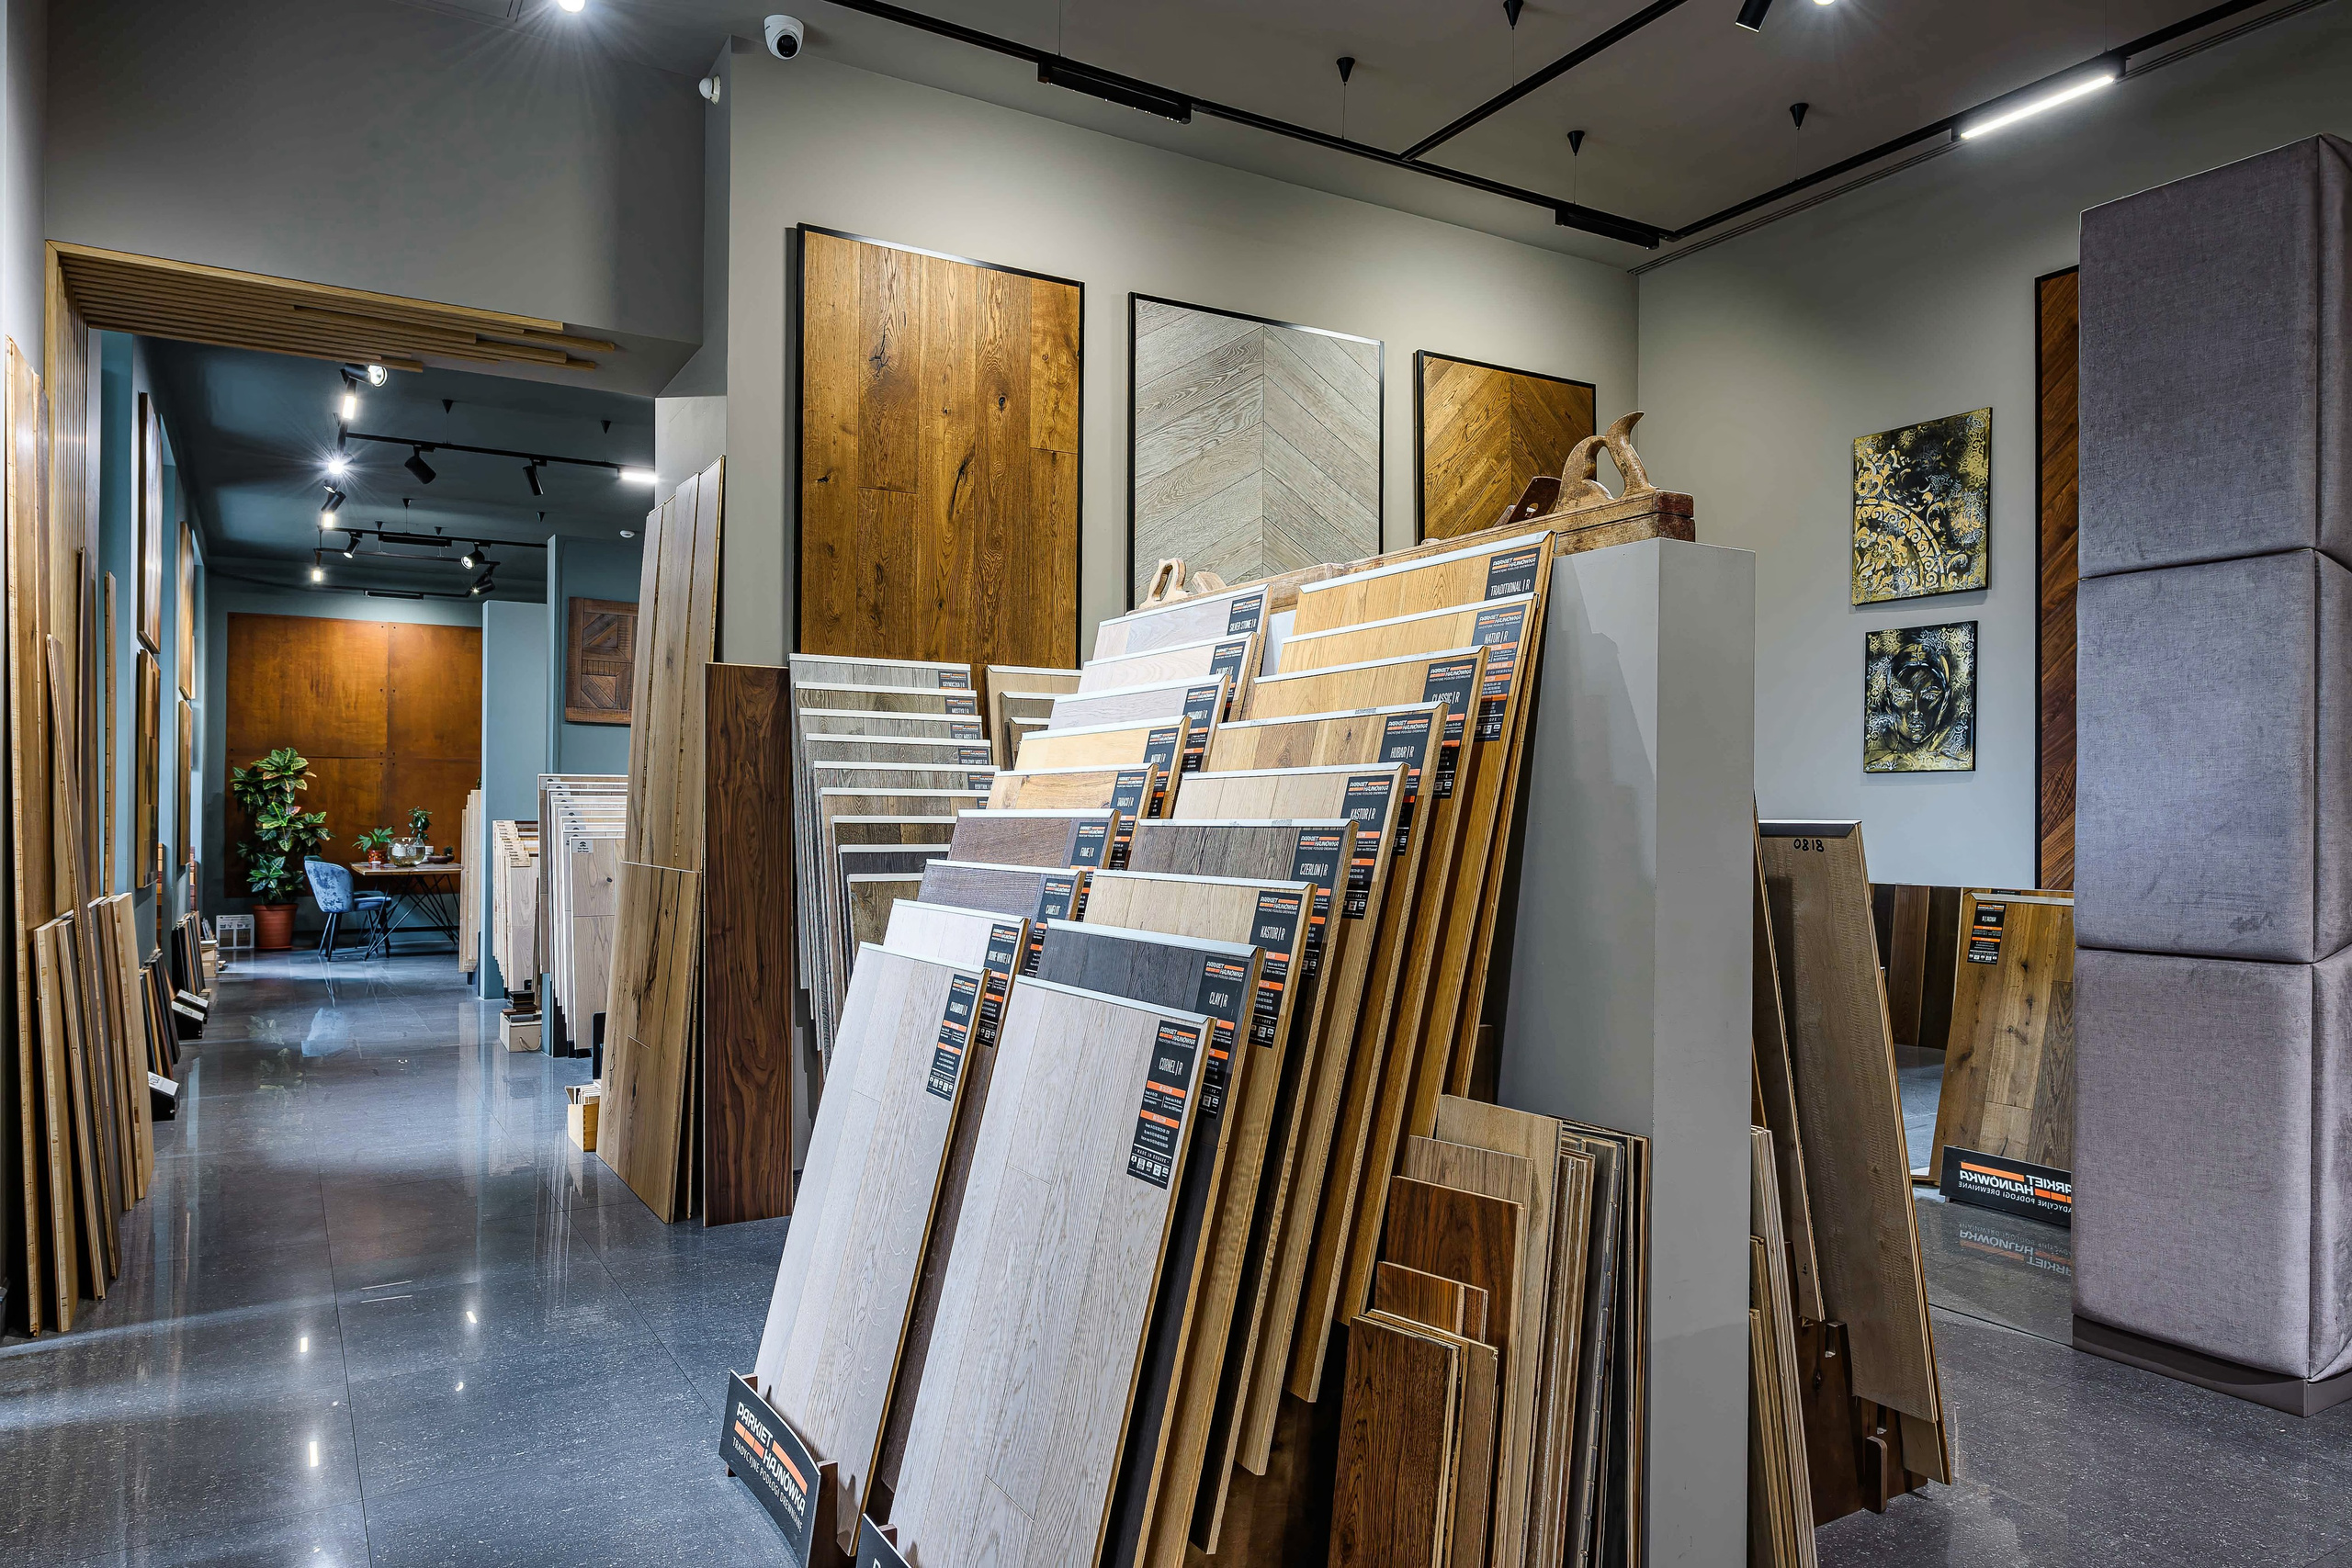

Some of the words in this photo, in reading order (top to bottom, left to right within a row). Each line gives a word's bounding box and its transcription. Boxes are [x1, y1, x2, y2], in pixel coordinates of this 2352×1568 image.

[1491, 581, 1521, 596] TRADITIONAL
[1525, 579, 1531, 590] R
[1484, 632, 1500, 644] NATUR
[1503, 631, 1509, 642] R
[1455, 692, 1460, 703] R
[1409, 746, 1415, 758] R
[1371, 808, 1376, 819] R
[1793, 839, 1825, 852] 0818
[1323, 864, 1329, 875] R
[1261, 926, 1278, 940] KASTOR
[1281, 928, 1285, 940] R
[1209, 992, 1223, 1005] CLAY
[1223, 994, 1228, 1007] R
[1178, 1062, 1182, 1075] R
[737, 1401, 773, 1448] PARKIET
[732, 1437, 760, 1473] TRADYCYJNE
[760, 1465, 779, 1498] PODŁOGI
[780, 1491, 803, 1533] DREWNIANE
[763, 1449, 806, 1517] HAJNÓWKA
